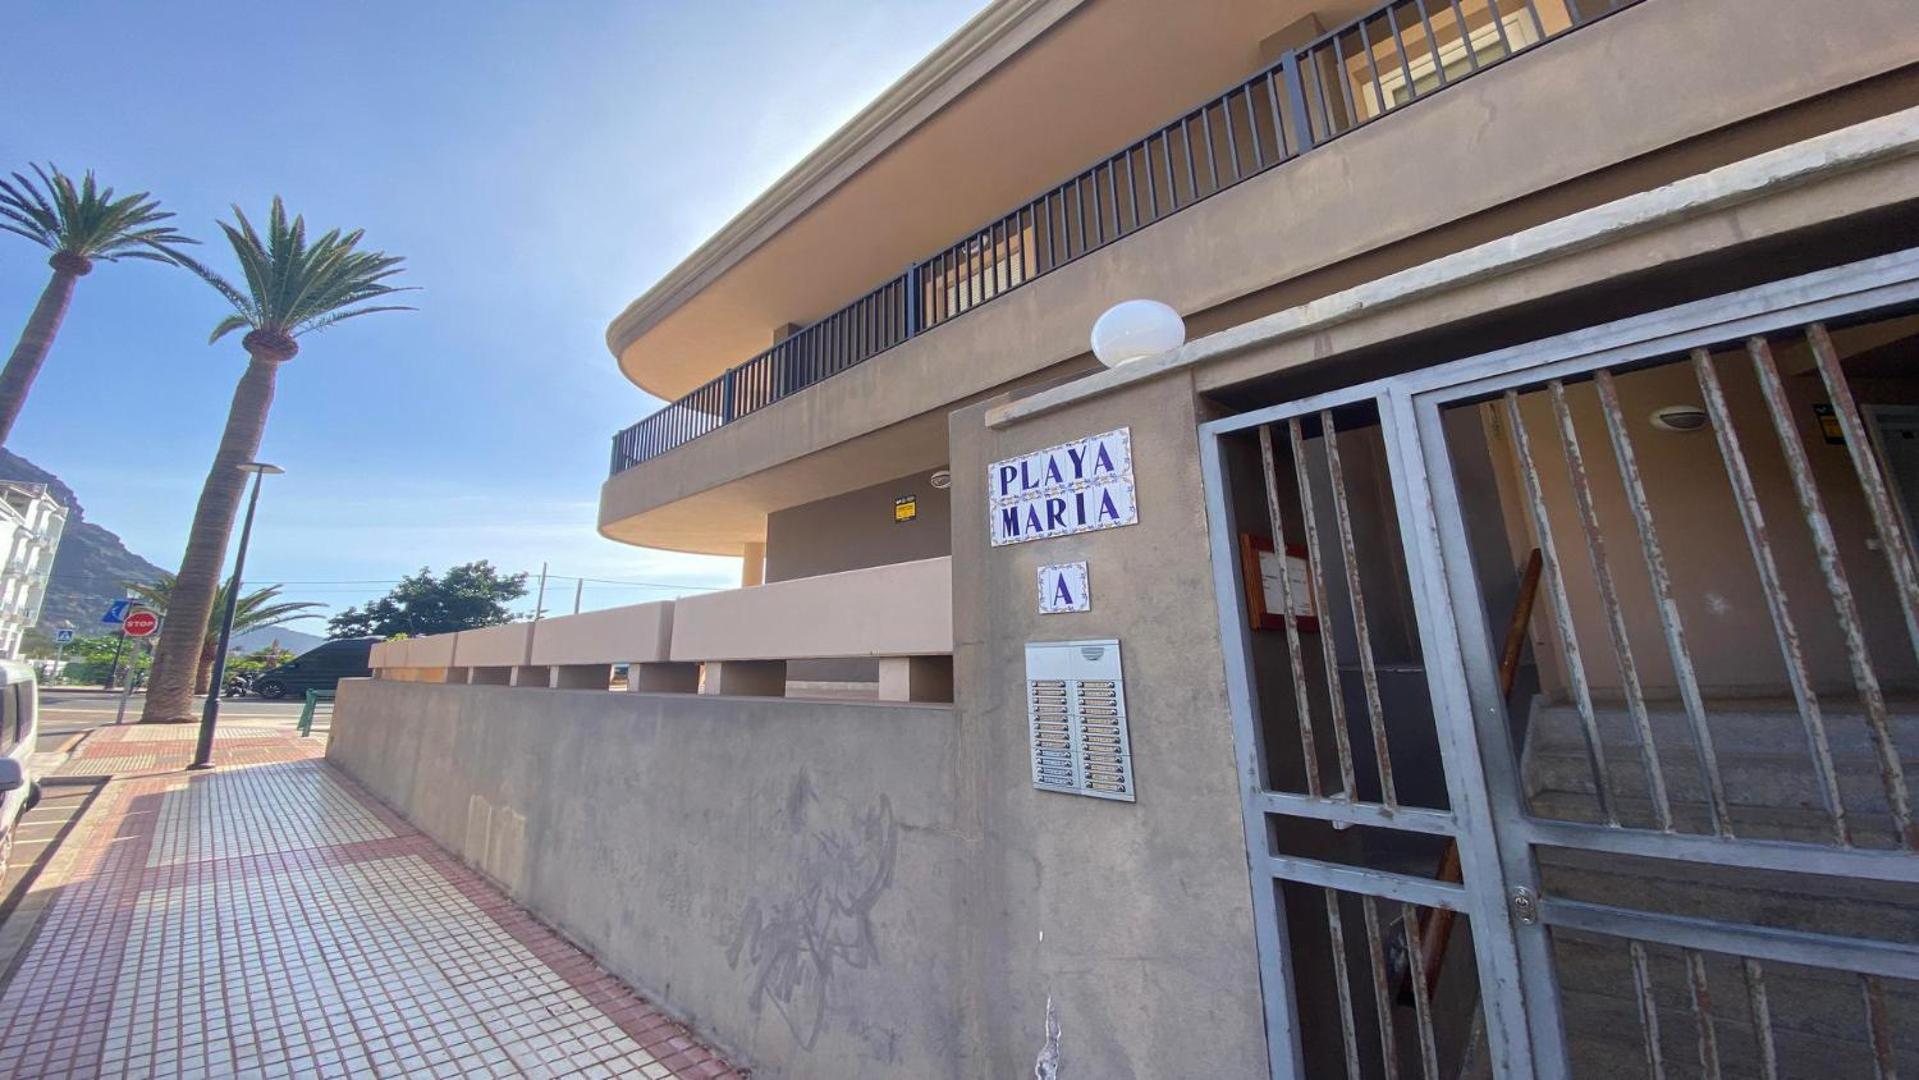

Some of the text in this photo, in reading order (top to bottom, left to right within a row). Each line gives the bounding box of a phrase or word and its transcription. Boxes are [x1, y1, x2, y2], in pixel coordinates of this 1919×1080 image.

[1000, 441, 1115, 496] PLAYA
[1002, 487, 1120, 538] MARIA
[1053, 572, 1073, 606] A
[127, 620, 154, 628] STOP
